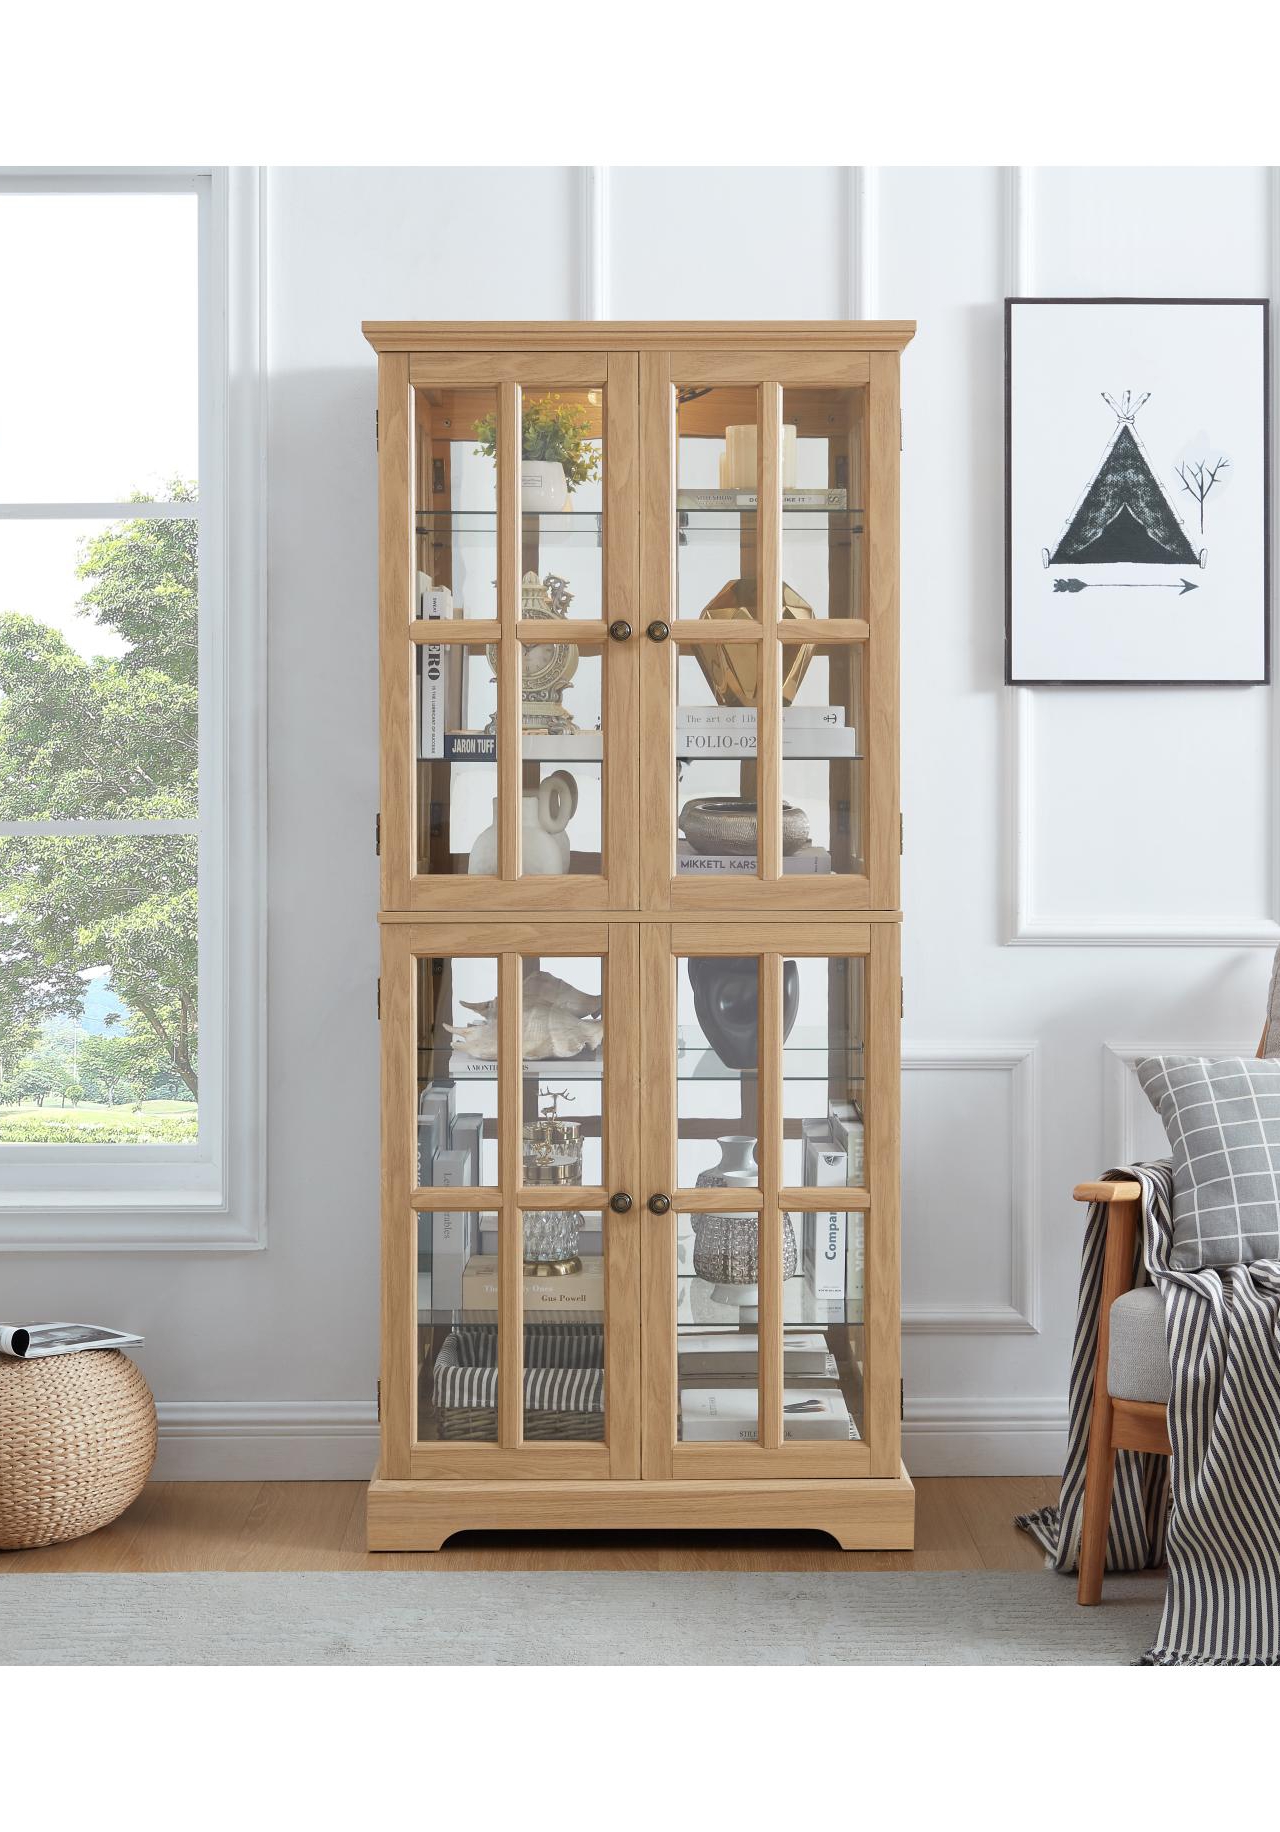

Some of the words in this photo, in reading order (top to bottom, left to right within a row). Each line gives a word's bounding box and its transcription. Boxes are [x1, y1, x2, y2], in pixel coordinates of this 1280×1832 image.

[686, 714, 701, 723] The
[706, 715, 720, 723] art
[727, 715, 736, 723] of
[452, 739, 476, 753] JARON
[477, 739, 494, 753] TUFF
[686, 735, 757, 748] FOLIO-02
[541, 1294, 556, 1302] Gus
[559, 1294, 586, 1302] Powell
